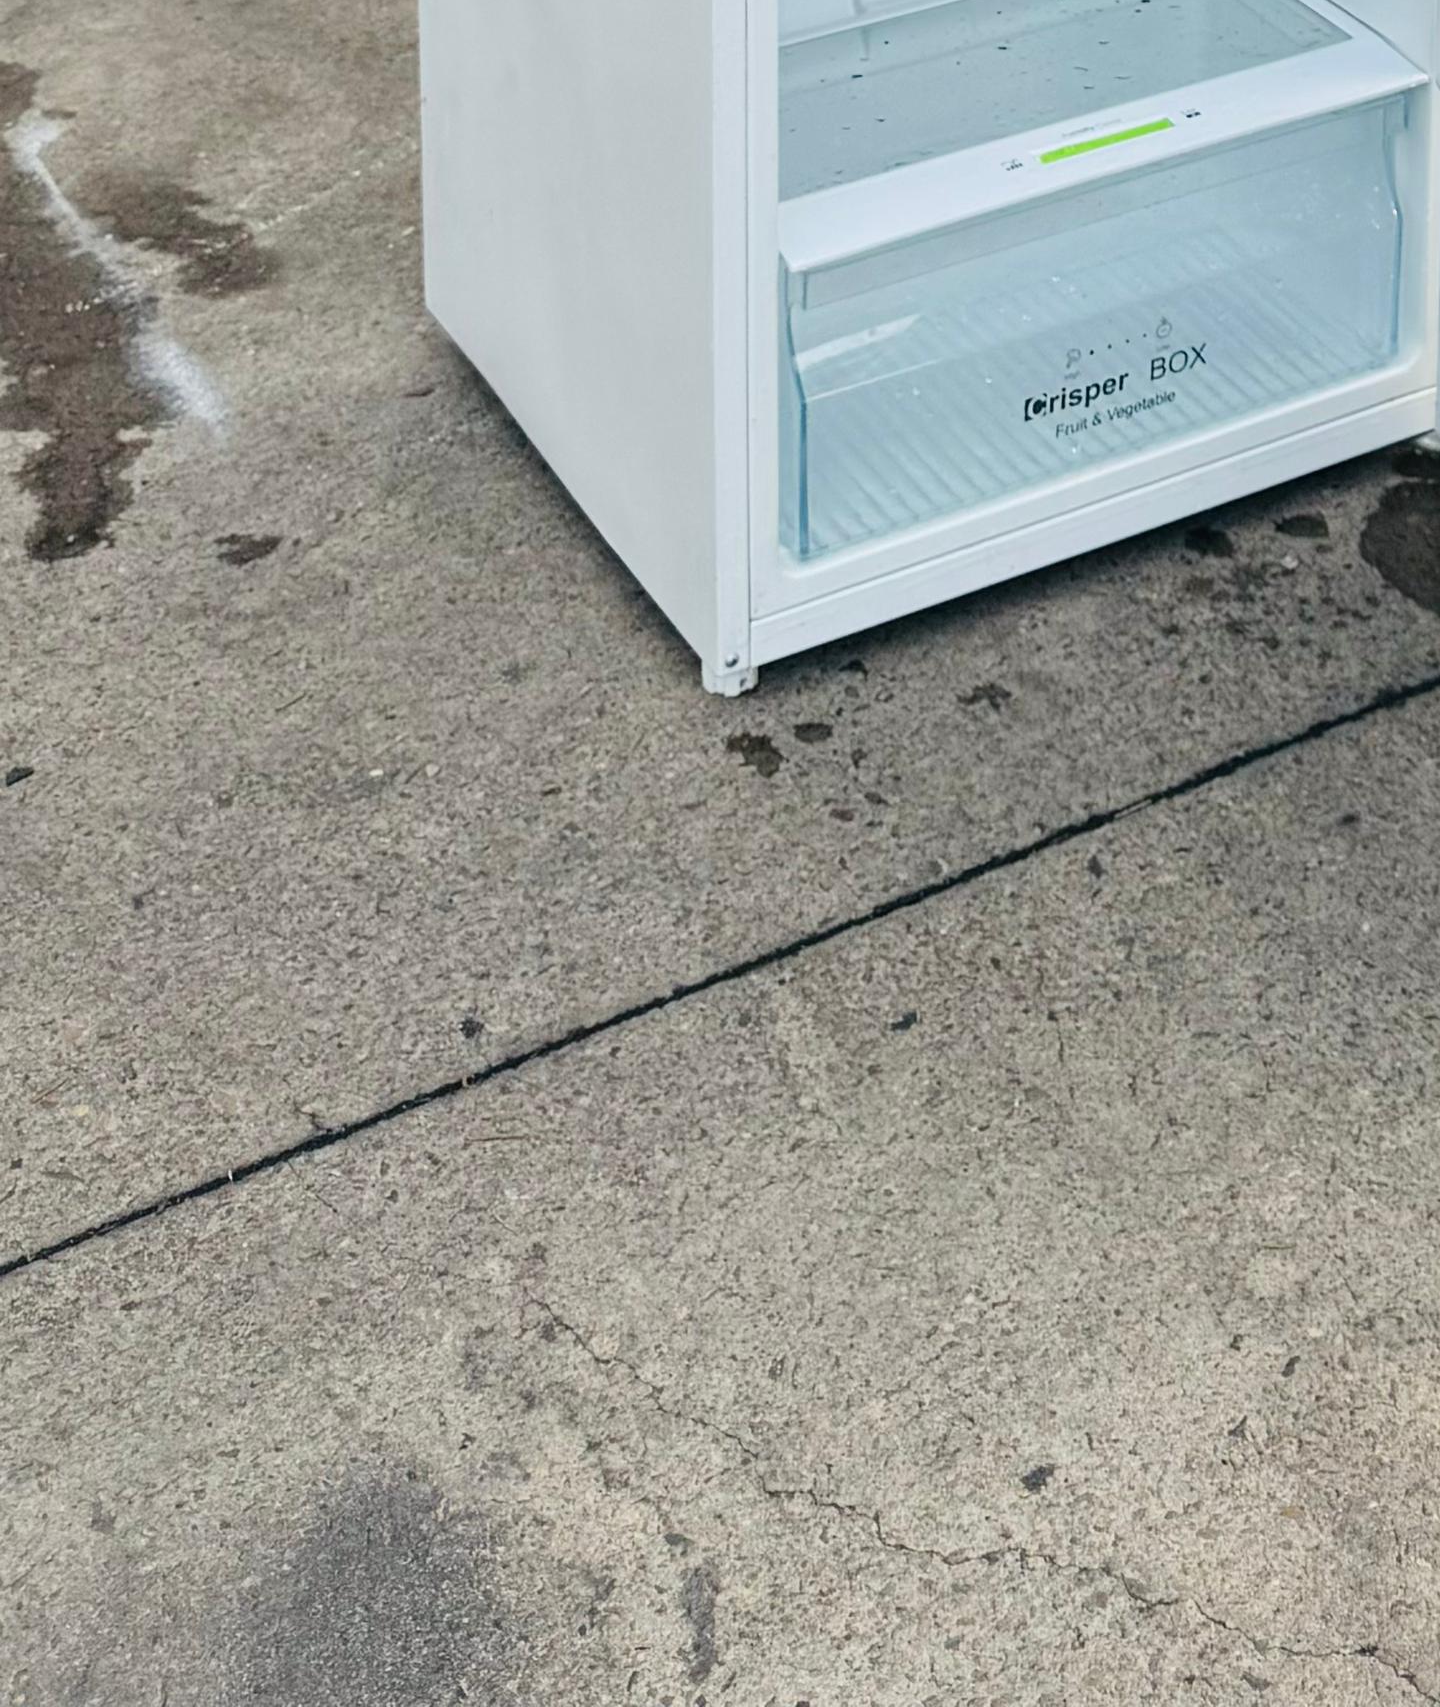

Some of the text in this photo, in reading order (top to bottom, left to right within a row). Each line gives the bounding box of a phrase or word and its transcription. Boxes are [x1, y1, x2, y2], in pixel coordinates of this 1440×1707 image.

[1150, 342, 1207, 381] BOX
[1055, 390, 1177, 438] Fruit & Vegetable
